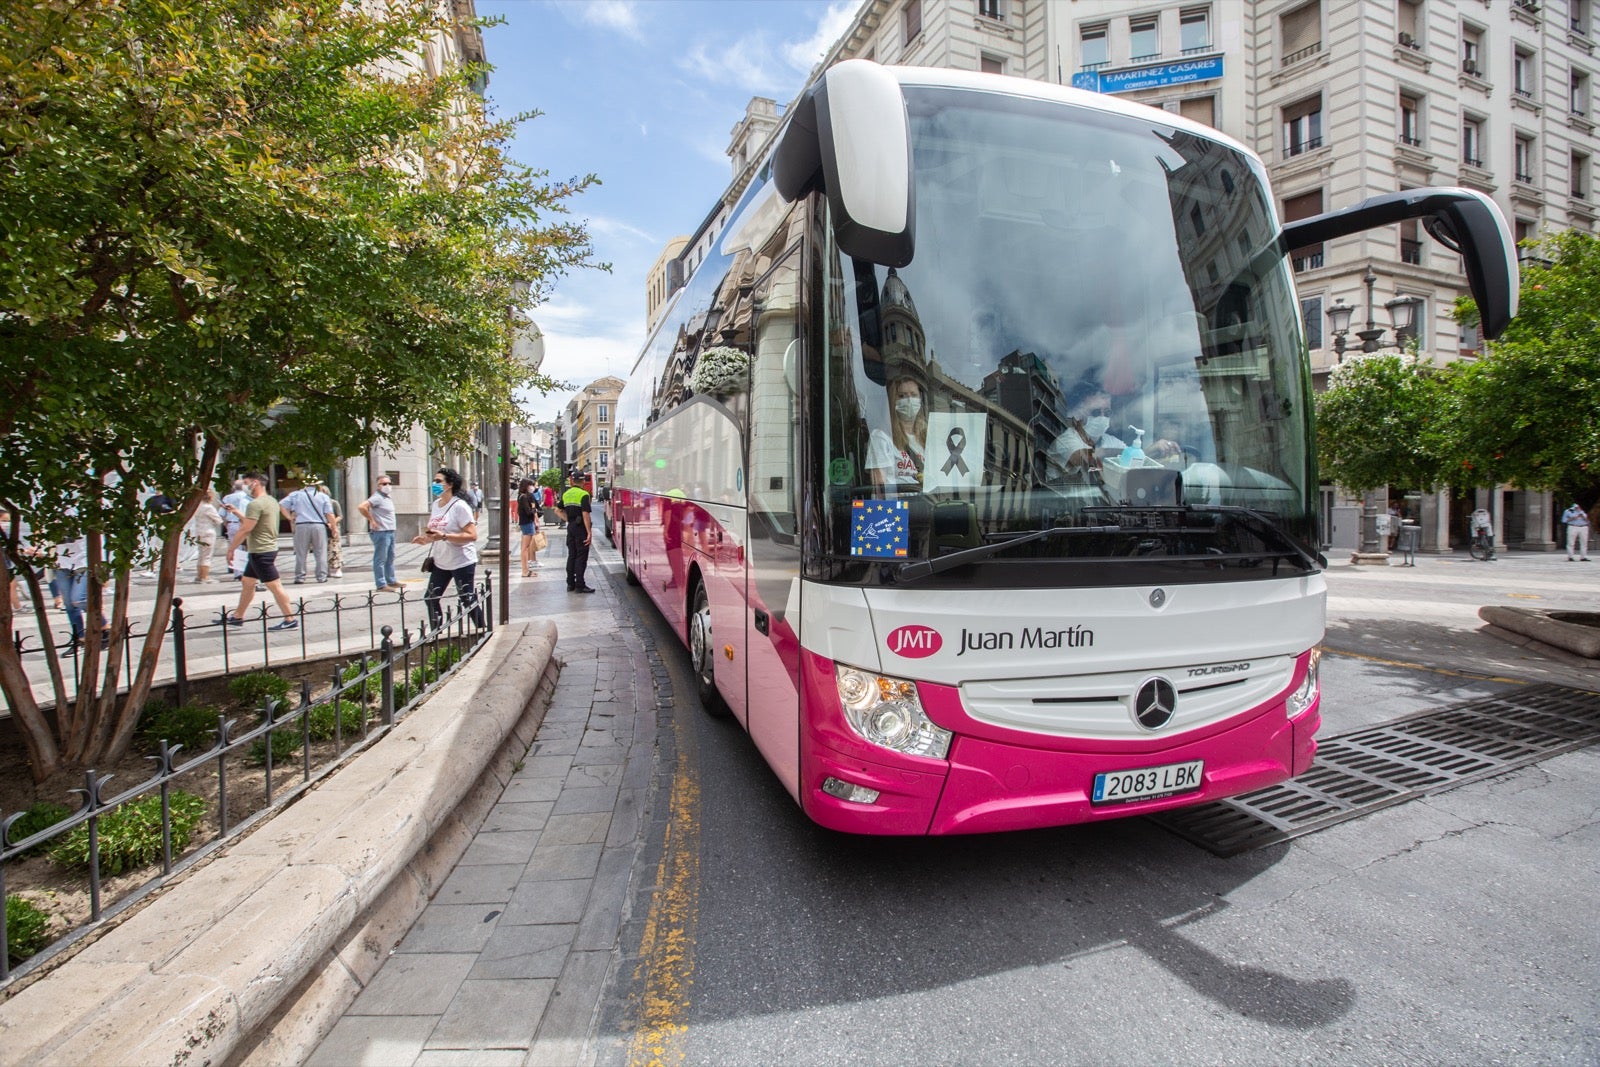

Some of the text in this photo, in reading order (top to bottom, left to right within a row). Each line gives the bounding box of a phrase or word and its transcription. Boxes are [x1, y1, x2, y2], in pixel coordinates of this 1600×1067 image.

[1168, 59, 1216, 73] CASARES
[1124, 79, 1158, 89] CORREDURIA
[1171, 73, 1198, 82] SEGUROS
[894, 629, 936, 653] JMT
[956, 624, 1094, 657] Juan Martín
[1187, 663, 1250, 677] TOURISMO
[1108, 764, 1198, 797] 2083 LBK
